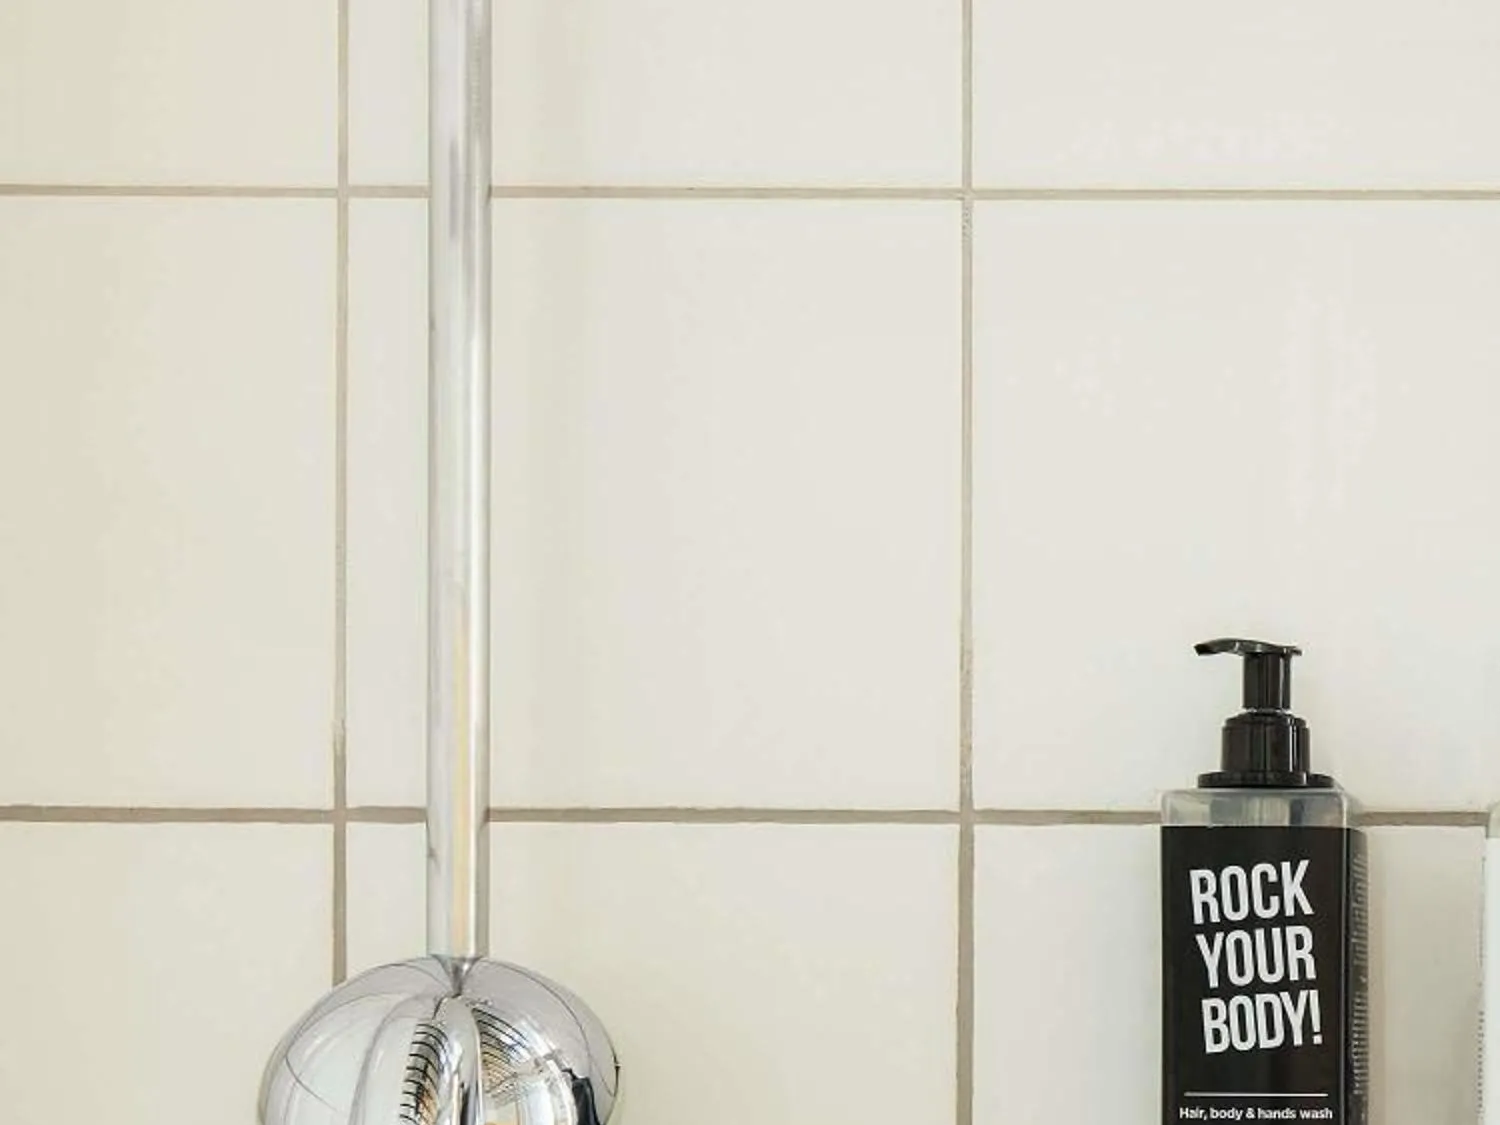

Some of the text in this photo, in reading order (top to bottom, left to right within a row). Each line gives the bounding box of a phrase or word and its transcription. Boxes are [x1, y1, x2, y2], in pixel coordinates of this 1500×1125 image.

[1189, 859, 1314, 925] ROCK
[1195, 925, 1317, 989] YOUR
[1201, 989, 1323, 1055] BODY!
[1179, 1106, 1333, 1121] Hair, body & hands wash
